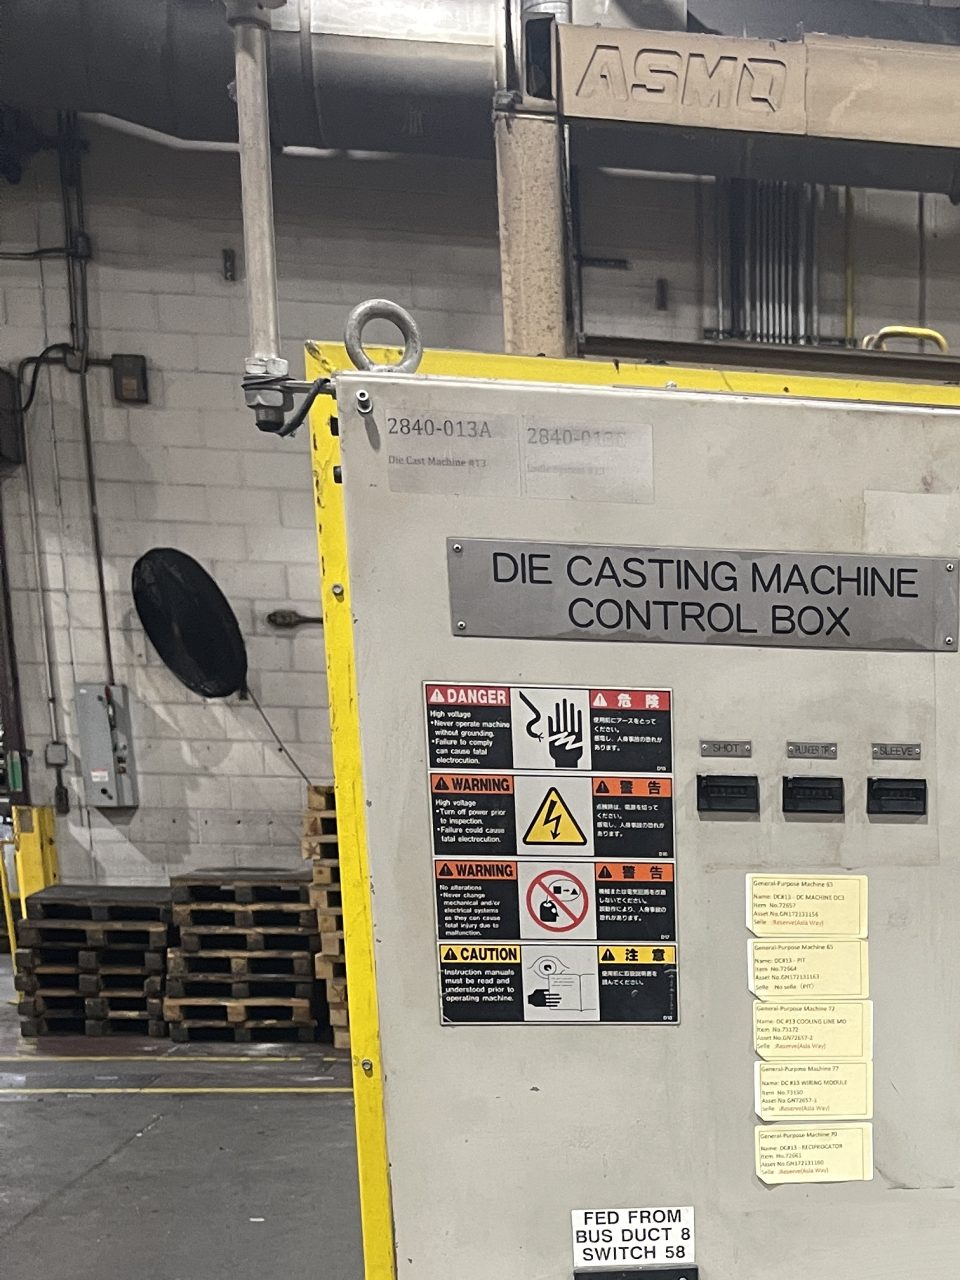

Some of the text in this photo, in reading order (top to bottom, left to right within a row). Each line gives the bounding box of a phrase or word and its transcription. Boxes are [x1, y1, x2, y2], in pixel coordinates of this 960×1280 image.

[387, 417, 492, 438] 2840-013A
[388, 455, 404, 464] Die
[406, 456, 425, 465] Cast
[428, 457, 466, 466] Machine
[493, 552, 918, 598] DIE CASTING MACHINE
[568, 597, 850, 636] CONTROL BOX
[447, 688, 506, 704] DANGER
[430, 710, 471, 719] High voltage
[712, 743, 740, 753] SHOT
[879, 746, 913, 756] SLEEVE
[451, 777, 510, 791] WARNING
[435, 799, 450, 807] High
[455, 863, 513, 877] WARNING
[460, 947, 517, 961] CAUTION
[444, 968, 482, 976] Instruction
[584, 1209, 682, 1225] FED FROM
[576, 1227, 691, 1243] BUS DUCT 8
[582, 1245, 686, 1261] SWITCH 58
